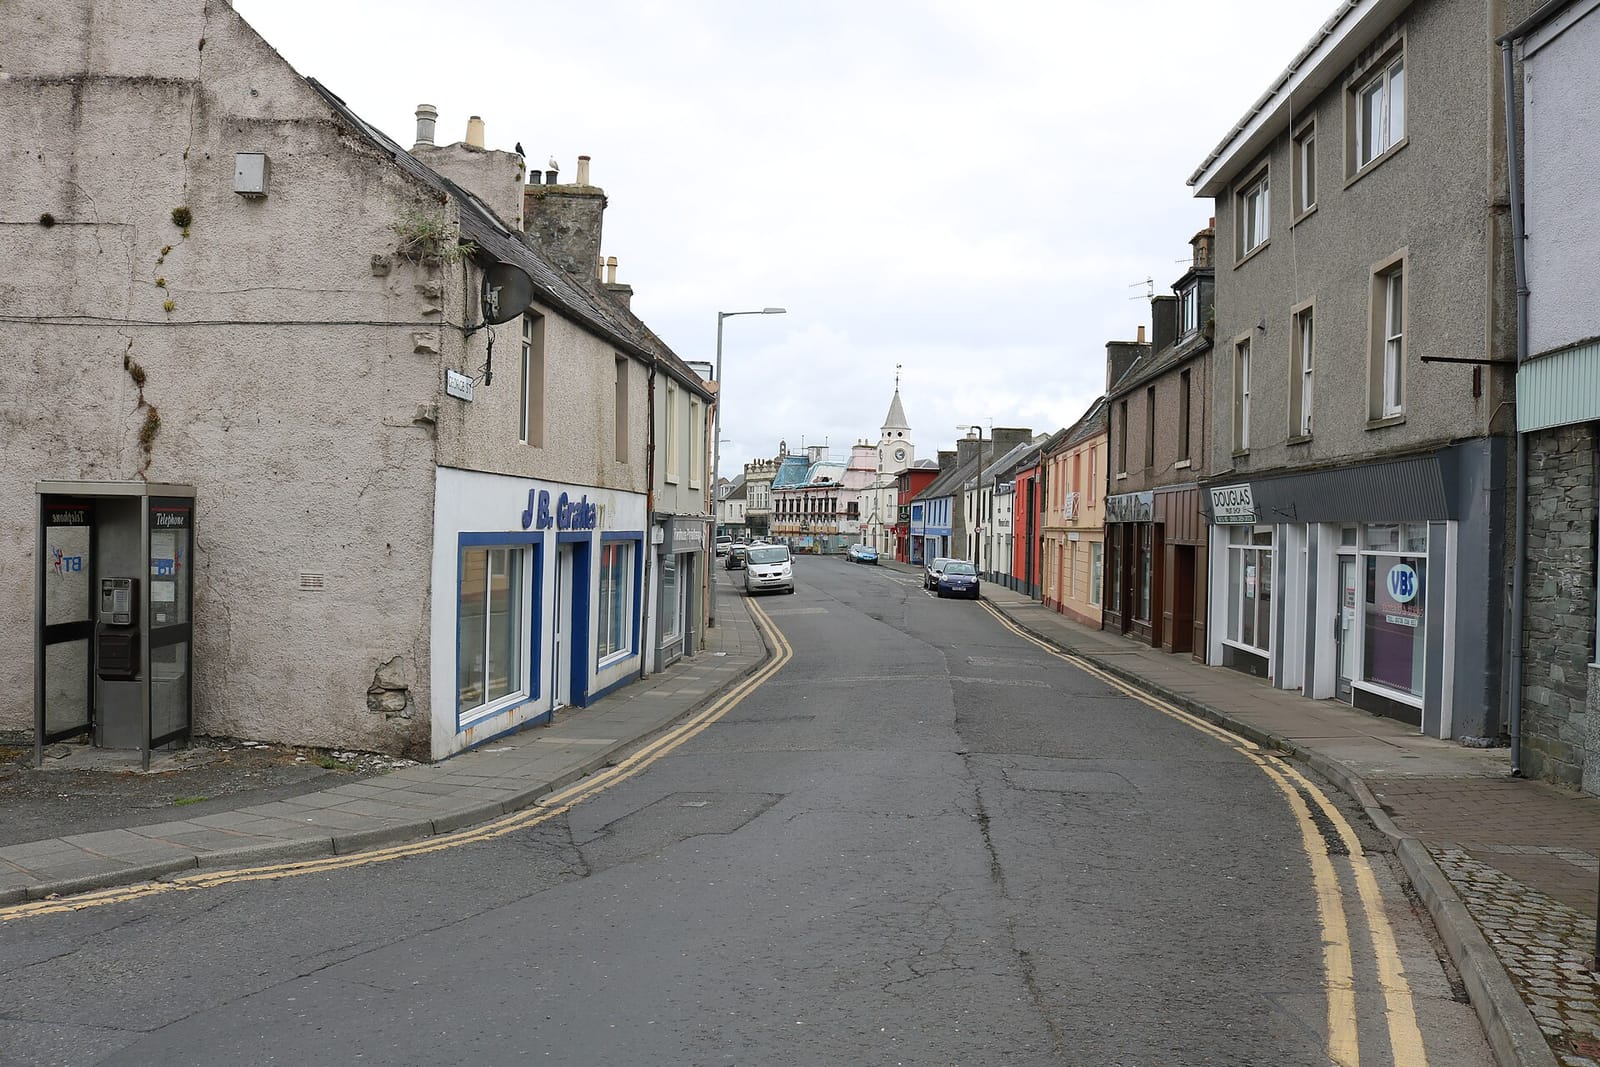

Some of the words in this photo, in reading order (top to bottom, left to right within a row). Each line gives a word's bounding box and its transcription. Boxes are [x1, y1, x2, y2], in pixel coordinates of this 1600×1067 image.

[522, 488, 536, 530] J
[1213, 488, 1251, 507] DOUGLAS
[156, 512, 184, 528] Telephone
[1391, 570, 1414, 597] VBS
